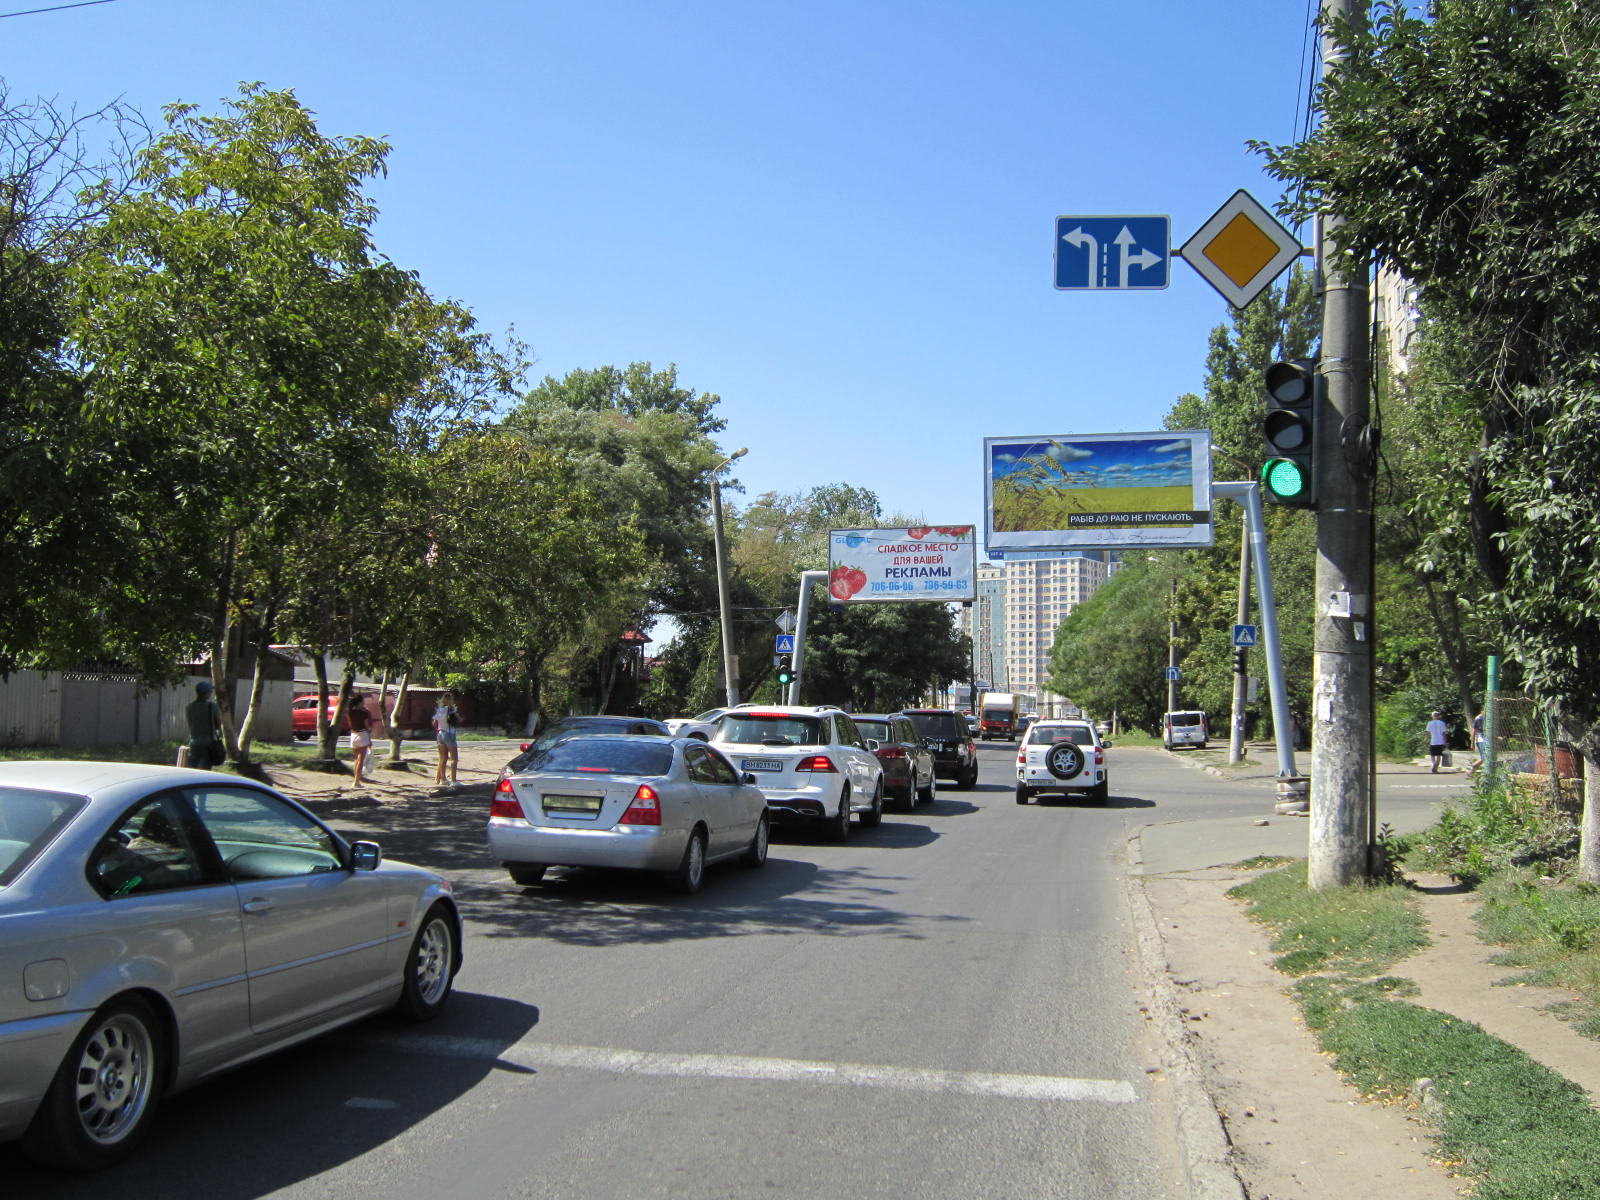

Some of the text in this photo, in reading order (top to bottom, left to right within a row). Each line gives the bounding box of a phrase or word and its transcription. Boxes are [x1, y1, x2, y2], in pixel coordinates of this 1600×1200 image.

[1070, 513, 1194, 523] РАБІВ ДО РАЮ НЕ ПУСКАЮТЬ.
[878, 543, 959, 553] СЛАДКОЕ МЕСТО
[893, 554, 944, 566] ДЛЯ ВАШЕЙ
[885, 566, 952, 578] РЕКЛАМЫ
